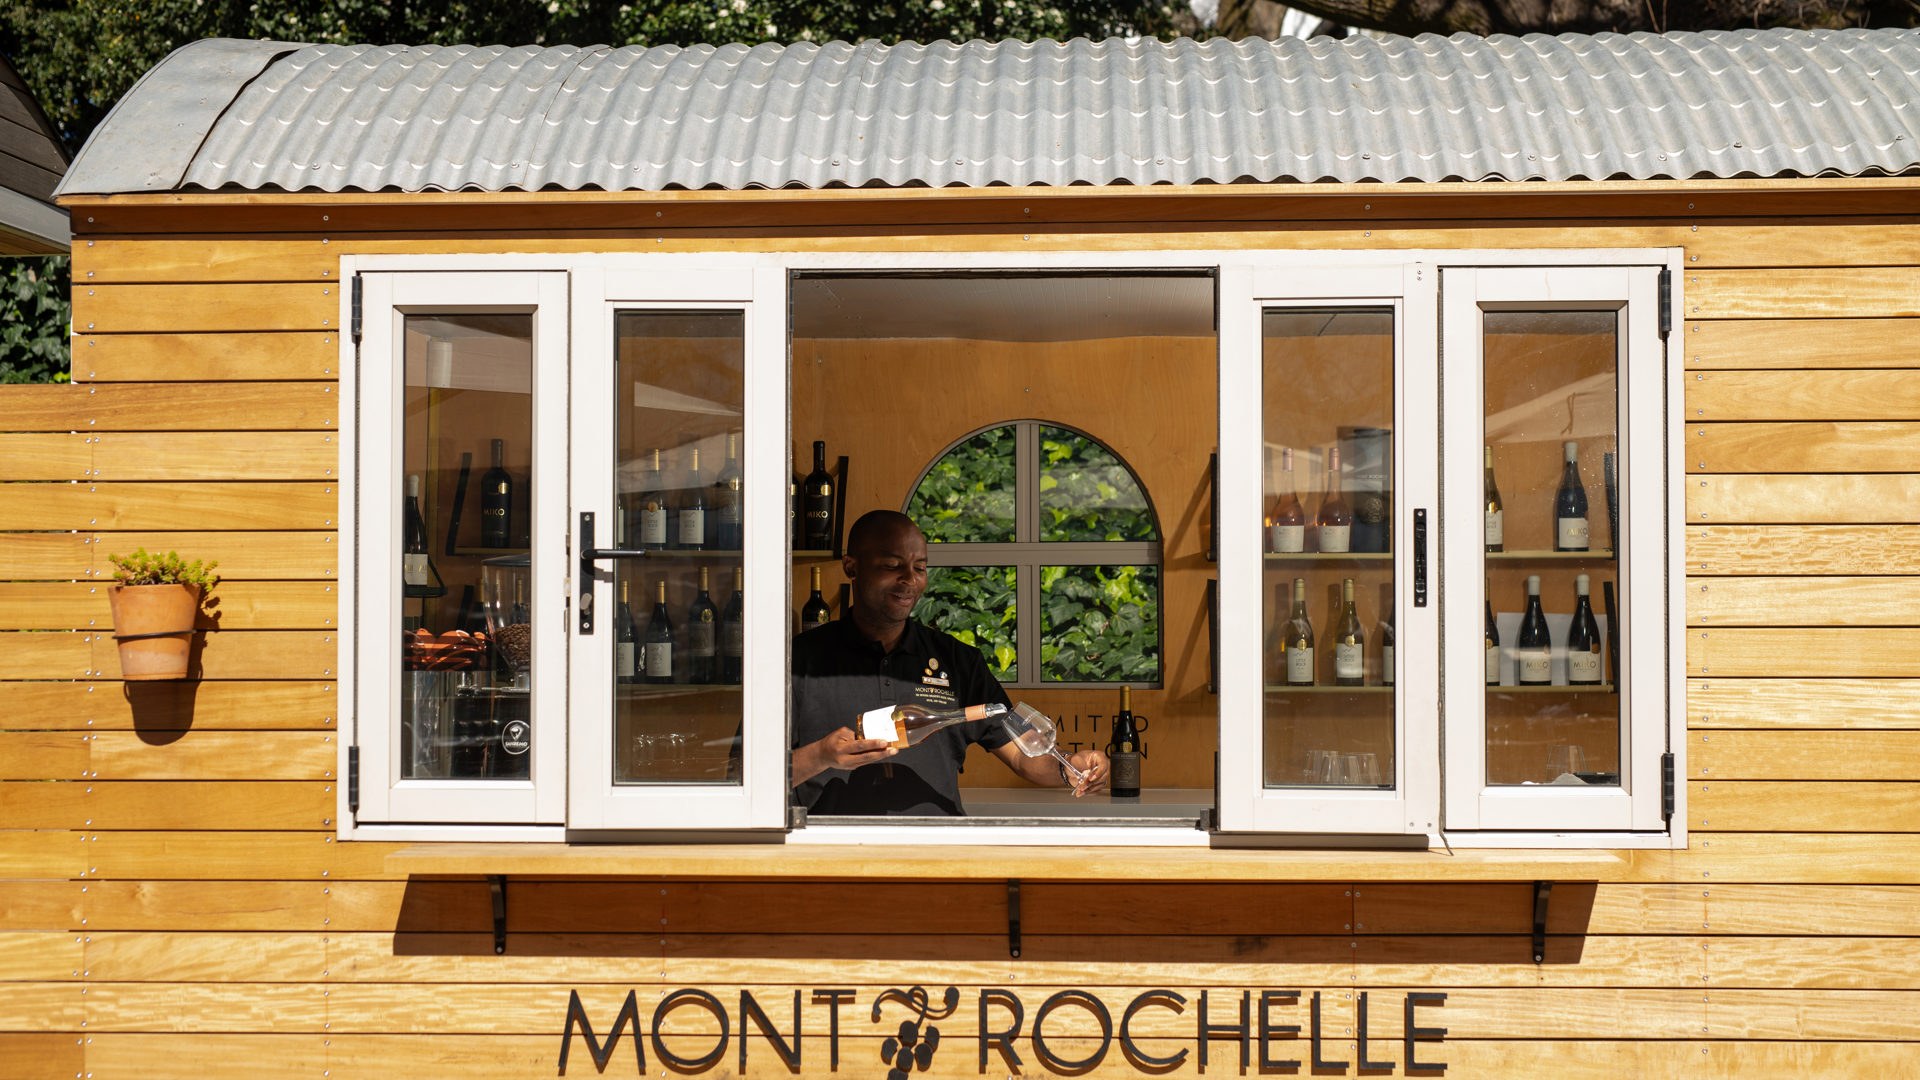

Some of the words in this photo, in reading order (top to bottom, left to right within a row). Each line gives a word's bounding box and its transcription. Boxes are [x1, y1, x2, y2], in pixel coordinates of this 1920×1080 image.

[483, 508, 505, 516] MIKO
[807, 510, 829, 519] MIKO
[1526, 661, 1548, 669] MIKO
[558, 988, 857, 1076] MONT
[979, 989, 1448, 1076] ROCHELLE
